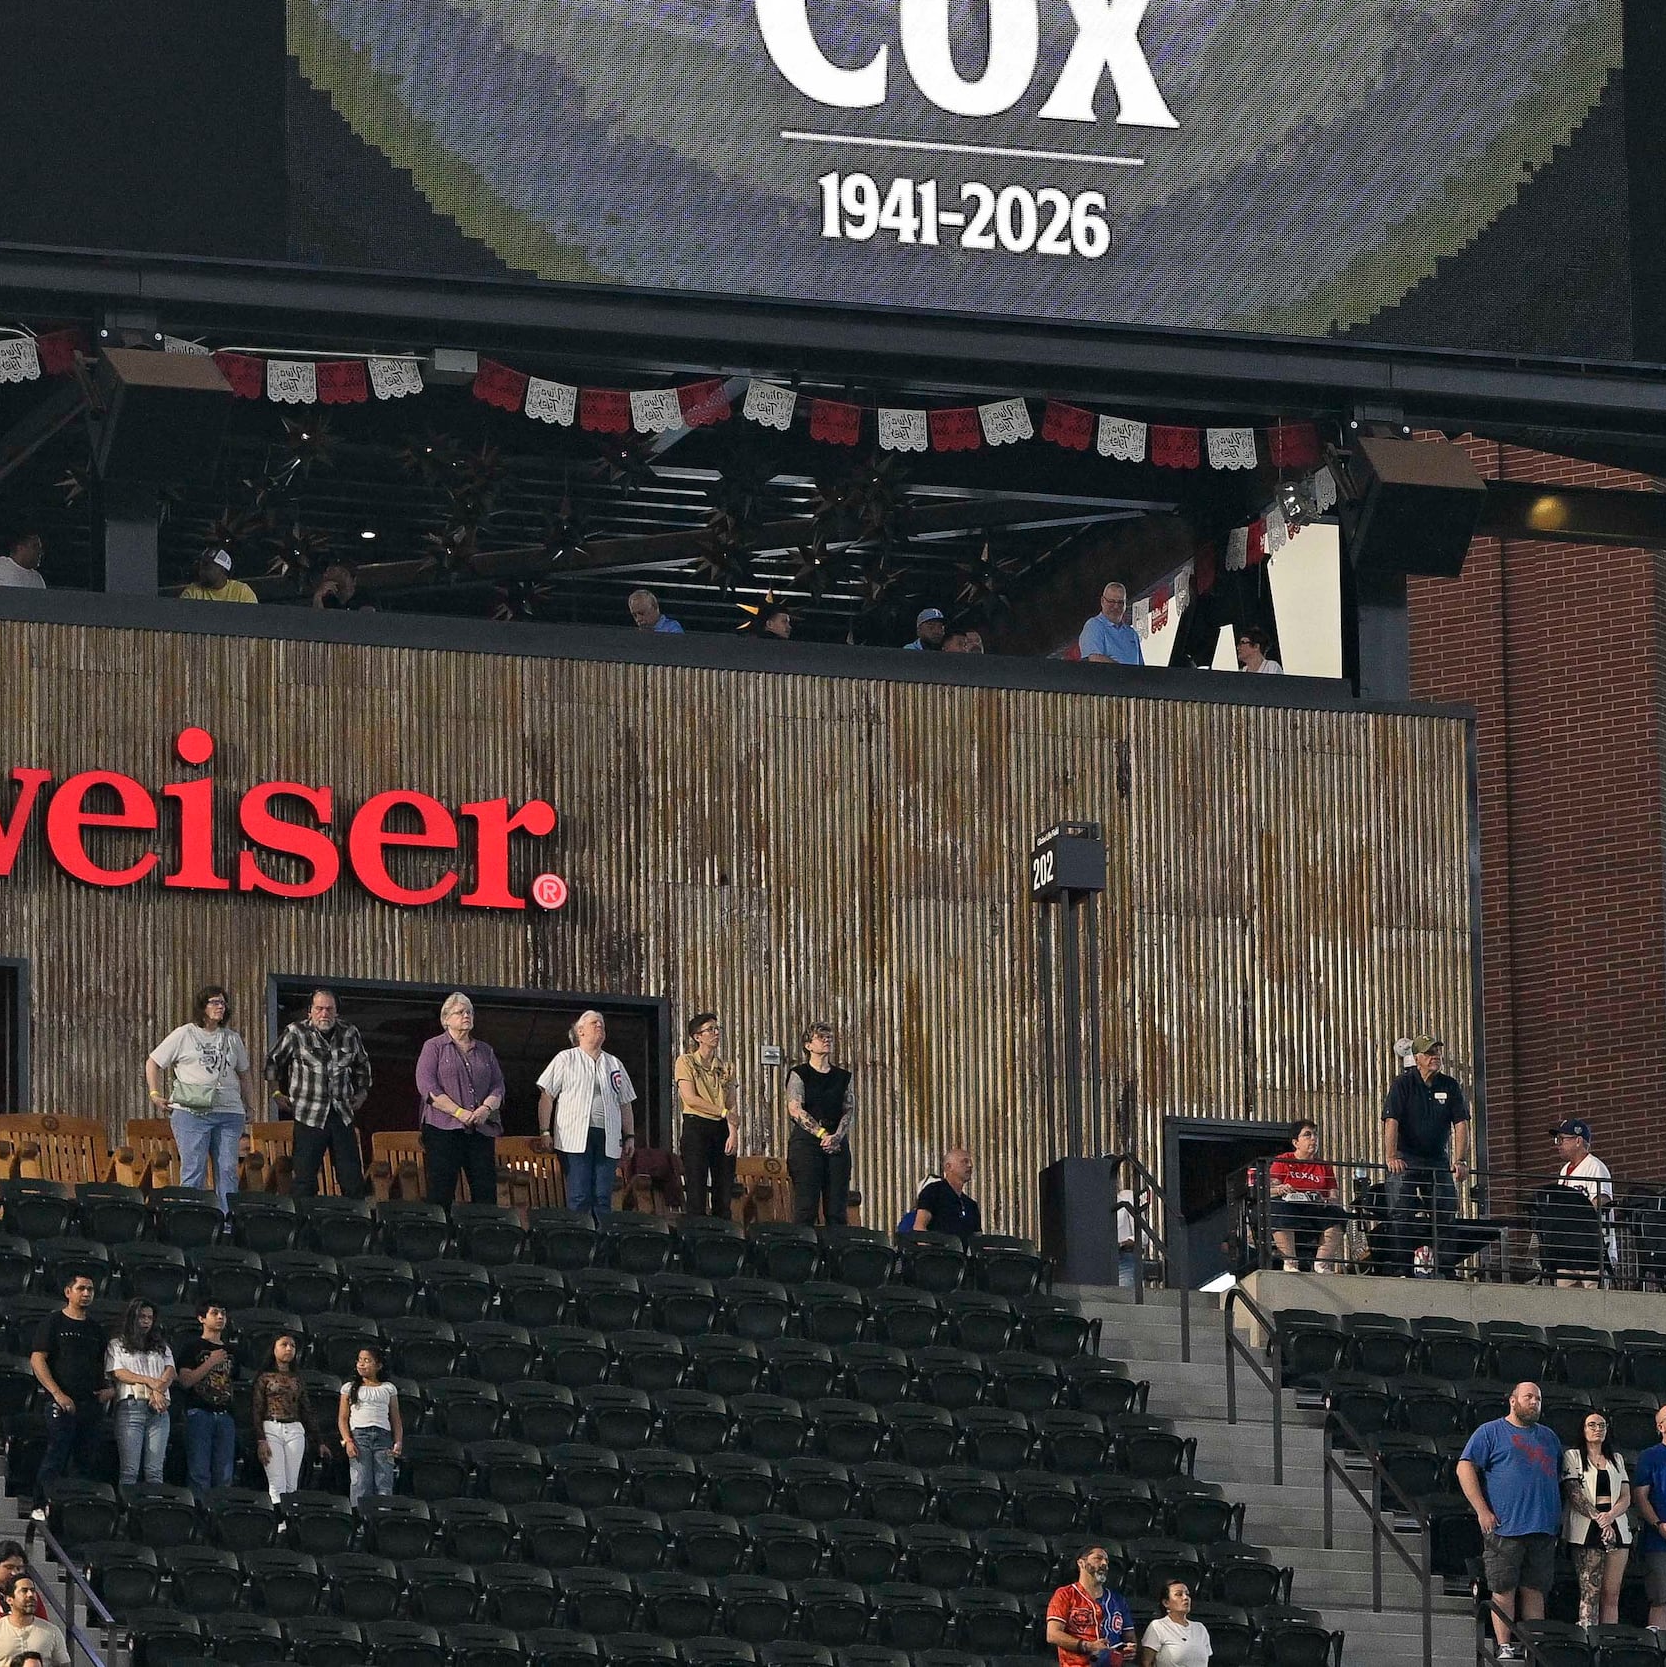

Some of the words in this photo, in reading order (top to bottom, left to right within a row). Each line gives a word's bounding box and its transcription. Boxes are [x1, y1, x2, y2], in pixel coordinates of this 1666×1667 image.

[818, 170, 1112, 260] 1941-2026
[1033, 850, 1053, 891] 202
[1289, 1171, 1321, 1183] TEXAS
